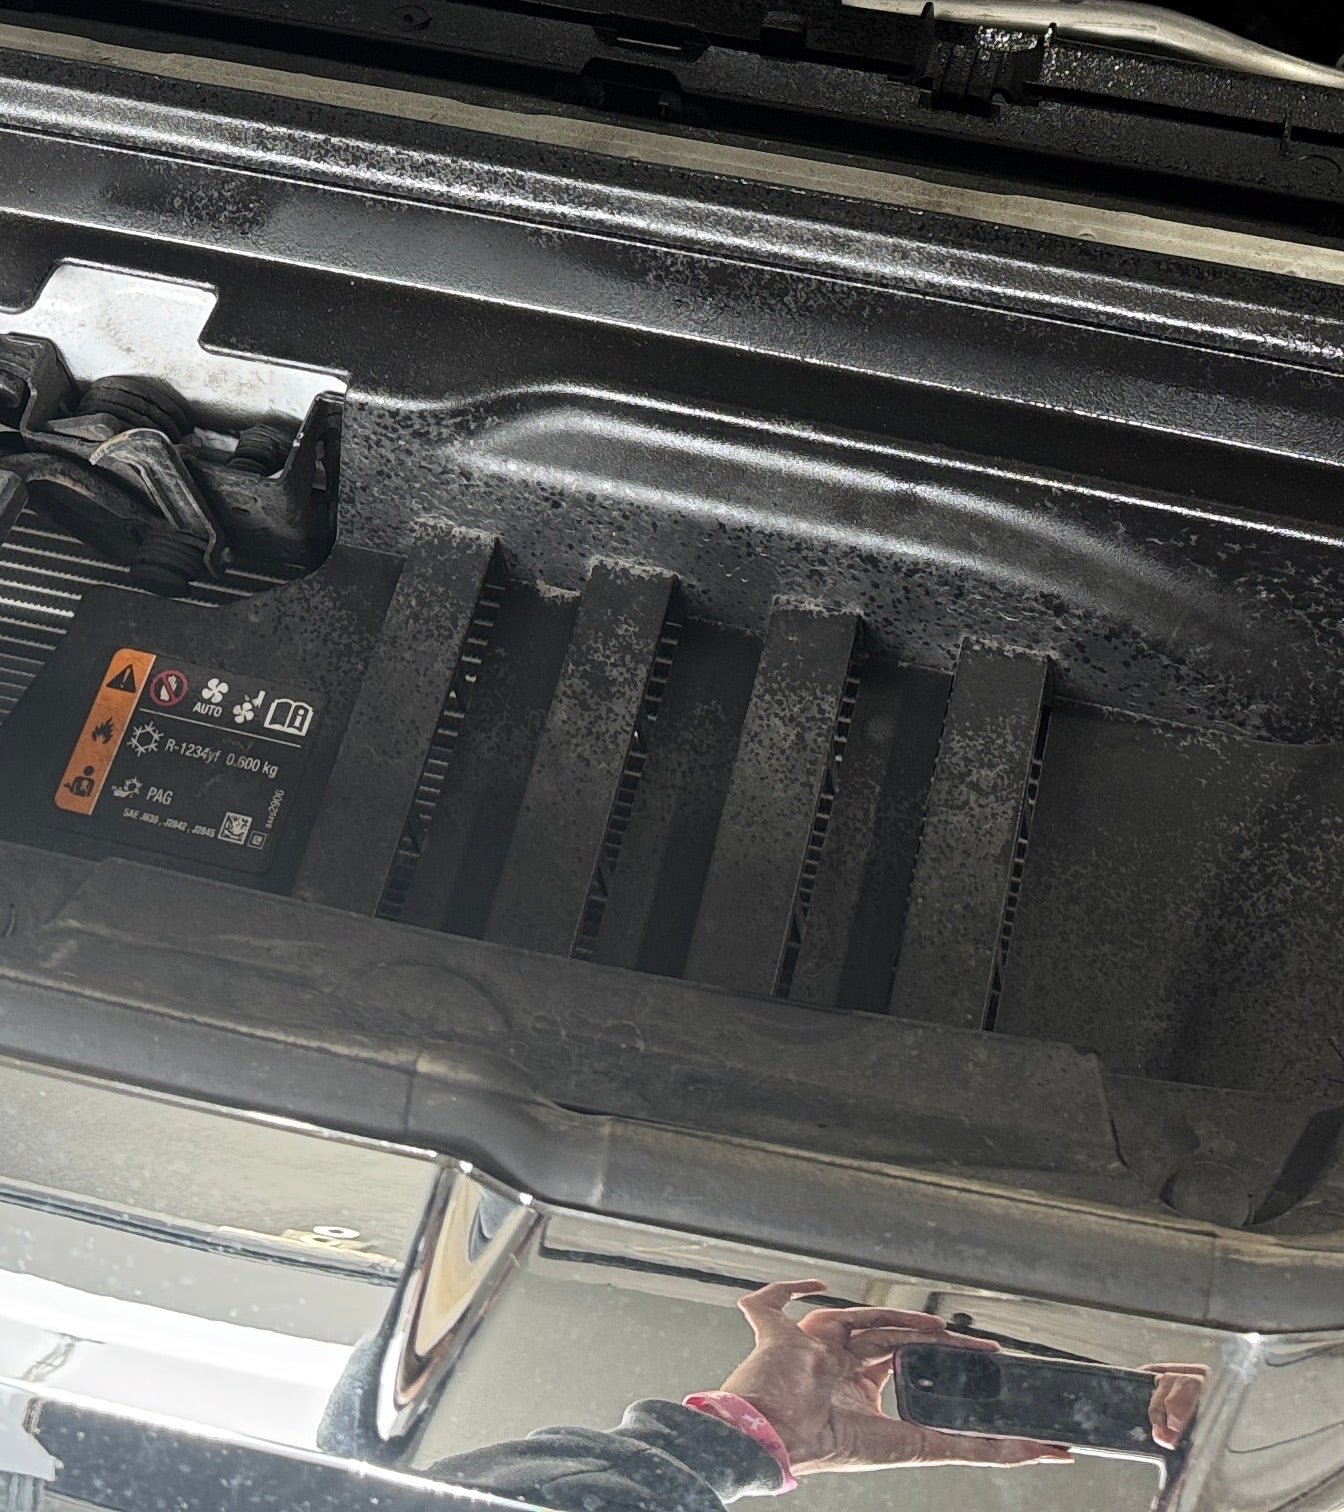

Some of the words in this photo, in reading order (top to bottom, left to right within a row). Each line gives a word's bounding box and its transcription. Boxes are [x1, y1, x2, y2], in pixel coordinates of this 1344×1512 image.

[192, 701, 223, 718] AUTO
[165, 738, 222, 763] R-1234yf
[226, 751, 261, 773] 0.600
[261, 760, 279, 779] kg
[145, 786, 174, 806] PAG
